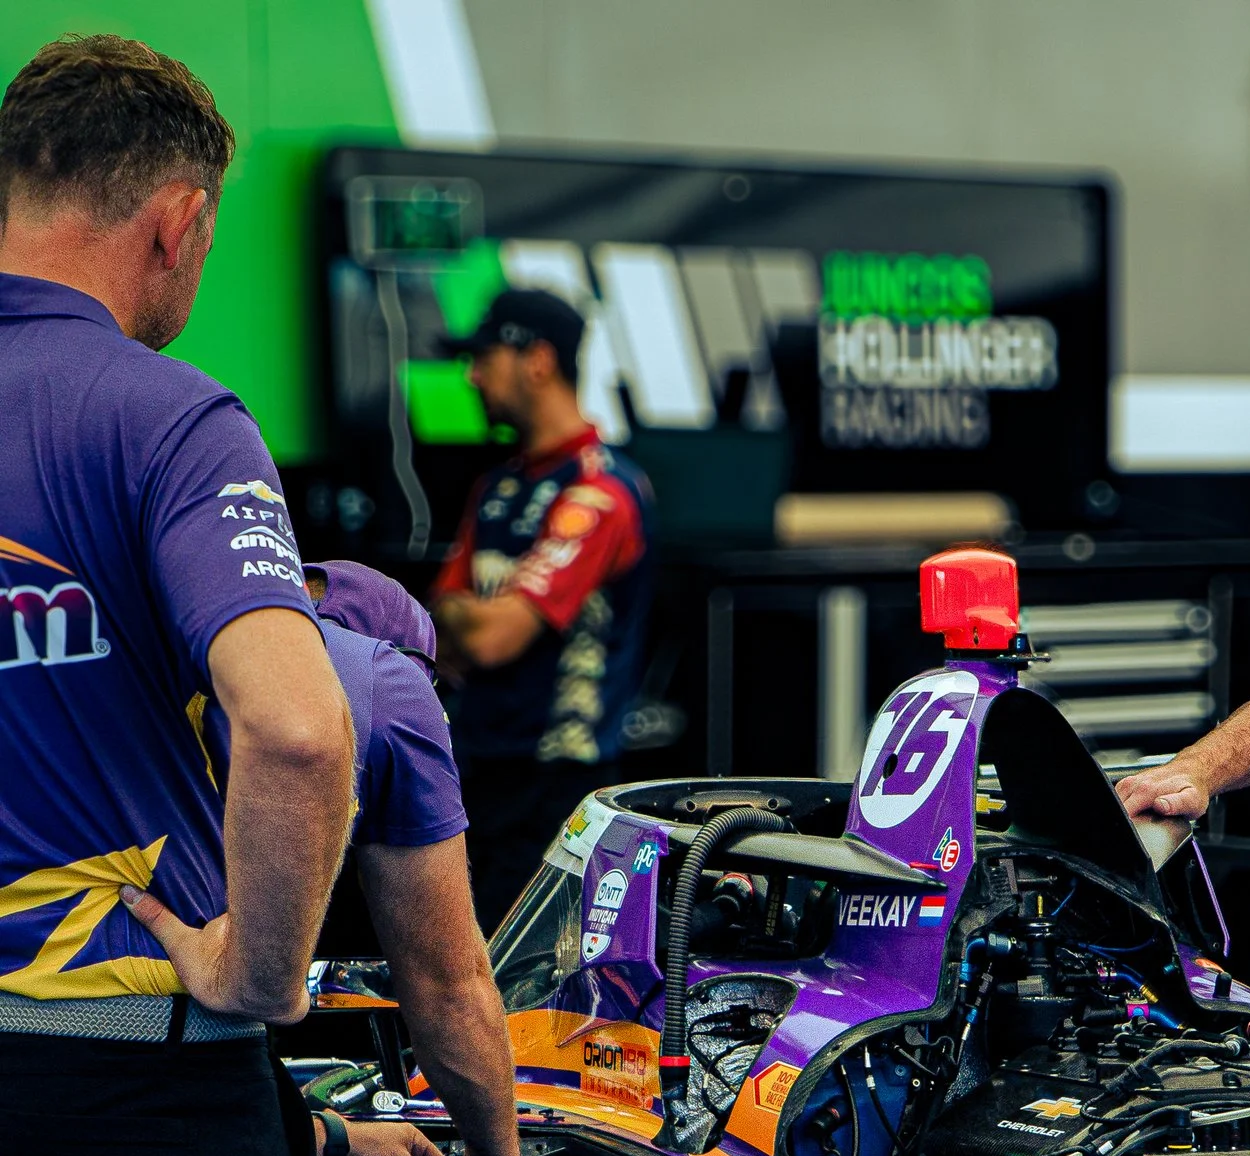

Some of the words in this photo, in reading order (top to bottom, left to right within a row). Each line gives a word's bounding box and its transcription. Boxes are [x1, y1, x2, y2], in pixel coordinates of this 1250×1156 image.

[242, 560, 303, 587] ARCO
[633, 844, 657, 870] PPG
[606, 886, 623, 902] NTT
[838, 895, 917, 927] VEEKAY
[997, 1119, 1065, 1138] CHEVROLET
